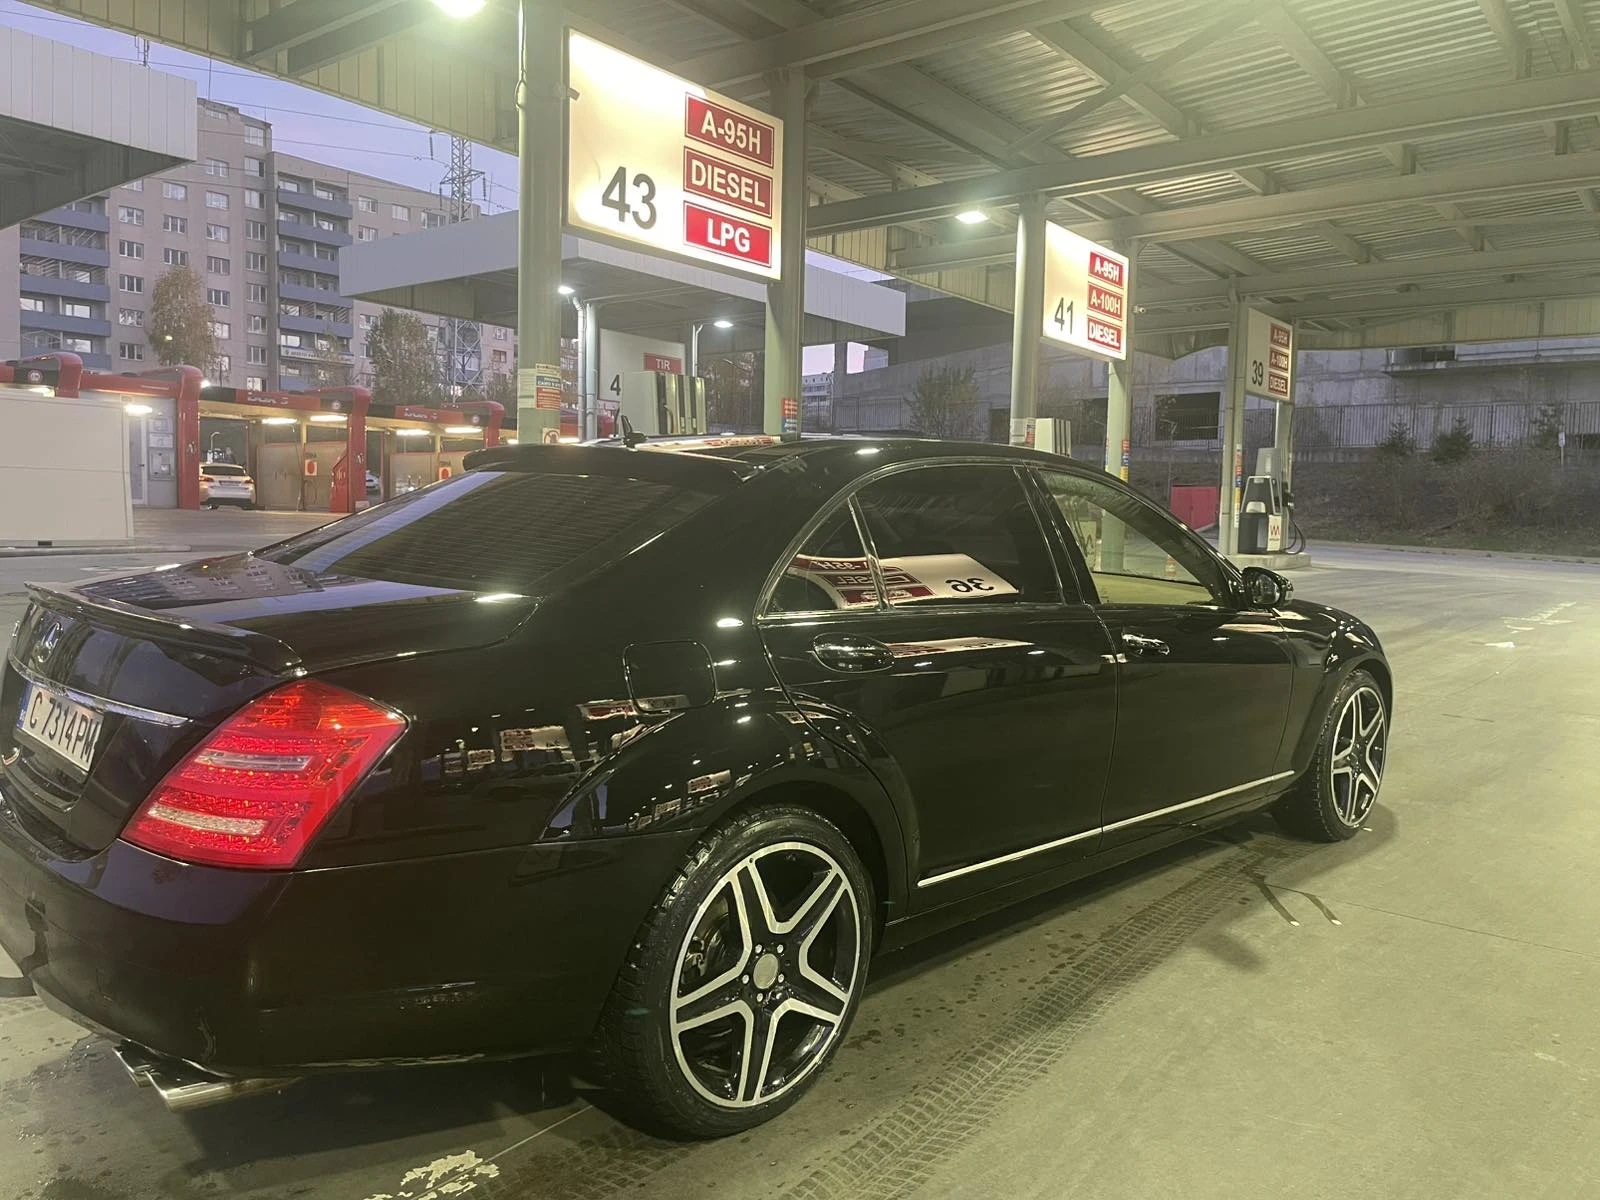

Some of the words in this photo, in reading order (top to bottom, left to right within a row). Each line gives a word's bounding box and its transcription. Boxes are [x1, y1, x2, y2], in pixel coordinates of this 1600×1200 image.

[701, 110, 761, 154] A-95H
[601, 165, 657, 230] 43
[691, 159, 766, 208] DIESEL
[706, 217, 751, 253] LPG
[1094, 256, 1120, 283] A-95H
[1054, 296, 1074, 335] 41
[1089, 289, 1121, 315] A-100H
[1088, 321, 1120, 348] DIESEL
[655, 358, 671, 371] TIR
[1252, 360, 1264, 386] 39
[29, 691, 42, 729] C
